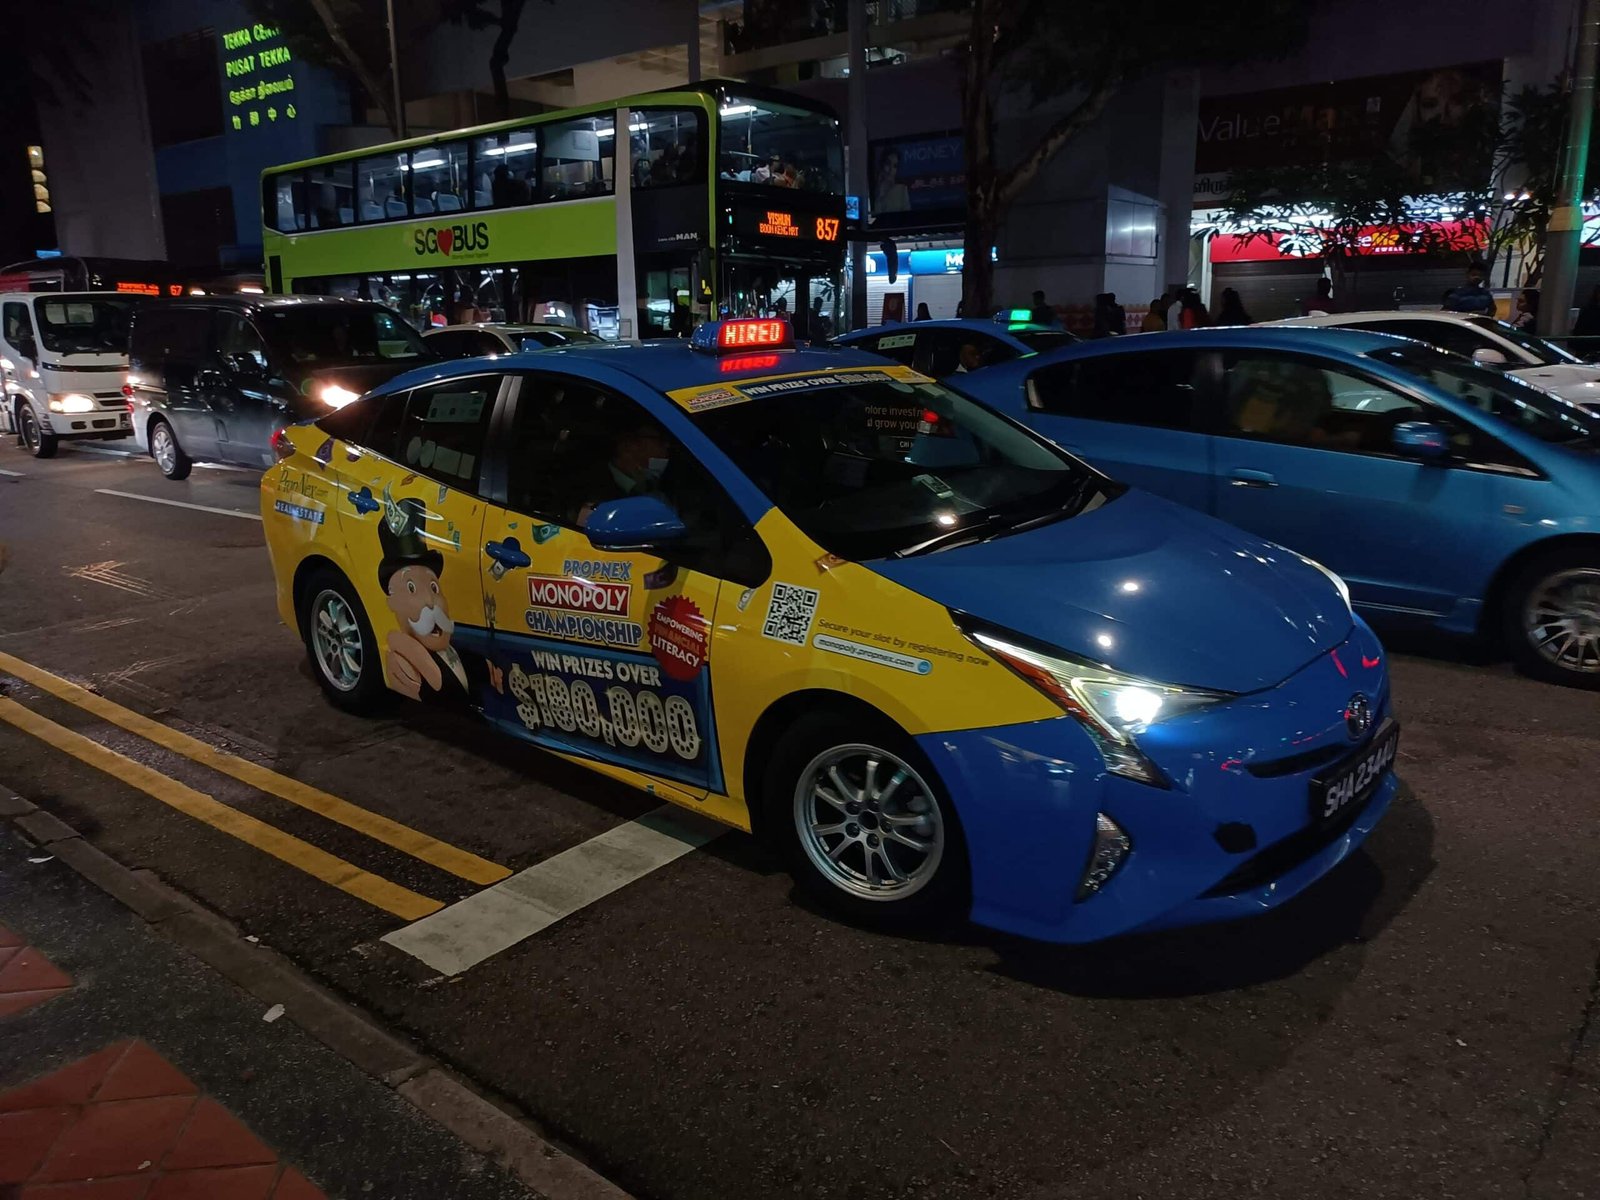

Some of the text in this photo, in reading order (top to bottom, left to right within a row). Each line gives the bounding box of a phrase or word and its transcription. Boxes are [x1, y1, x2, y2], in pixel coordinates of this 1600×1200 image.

[223, 29, 252, 50] TEKKA
[225, 47, 291, 78] PUSAT TEKKA
[904, 144, 960, 161] MONEY
[760, 223, 774, 233] BOON
[789, 226, 799, 236] MRT
[767, 211, 791, 226] YISHUN
[816, 218, 839, 240] 857
[676, 232, 697, 240] MAN
[169, 284, 182, 296] 67
[725, 322, 781, 344] HIRED
[743, 384, 769, 395] WIN
[771, 380, 808, 392] PRIZES
[809, 377, 836, 387] OVER
[875, 419, 897, 430] grow
[563, 560, 633, 580] PROPNEX
[531, 582, 627, 611] MONOPOLY
[525, 609, 643, 646] CHAMPIONSHIP
[656, 612, 704, 642] EMPOWERING
[652, 634, 699, 667] LITERACY
[818, 619, 990, 667] Secure your slot by registering now
[531, 650, 662, 687] WIN PRIZES OVER
[508, 663, 701, 760] $180,000
